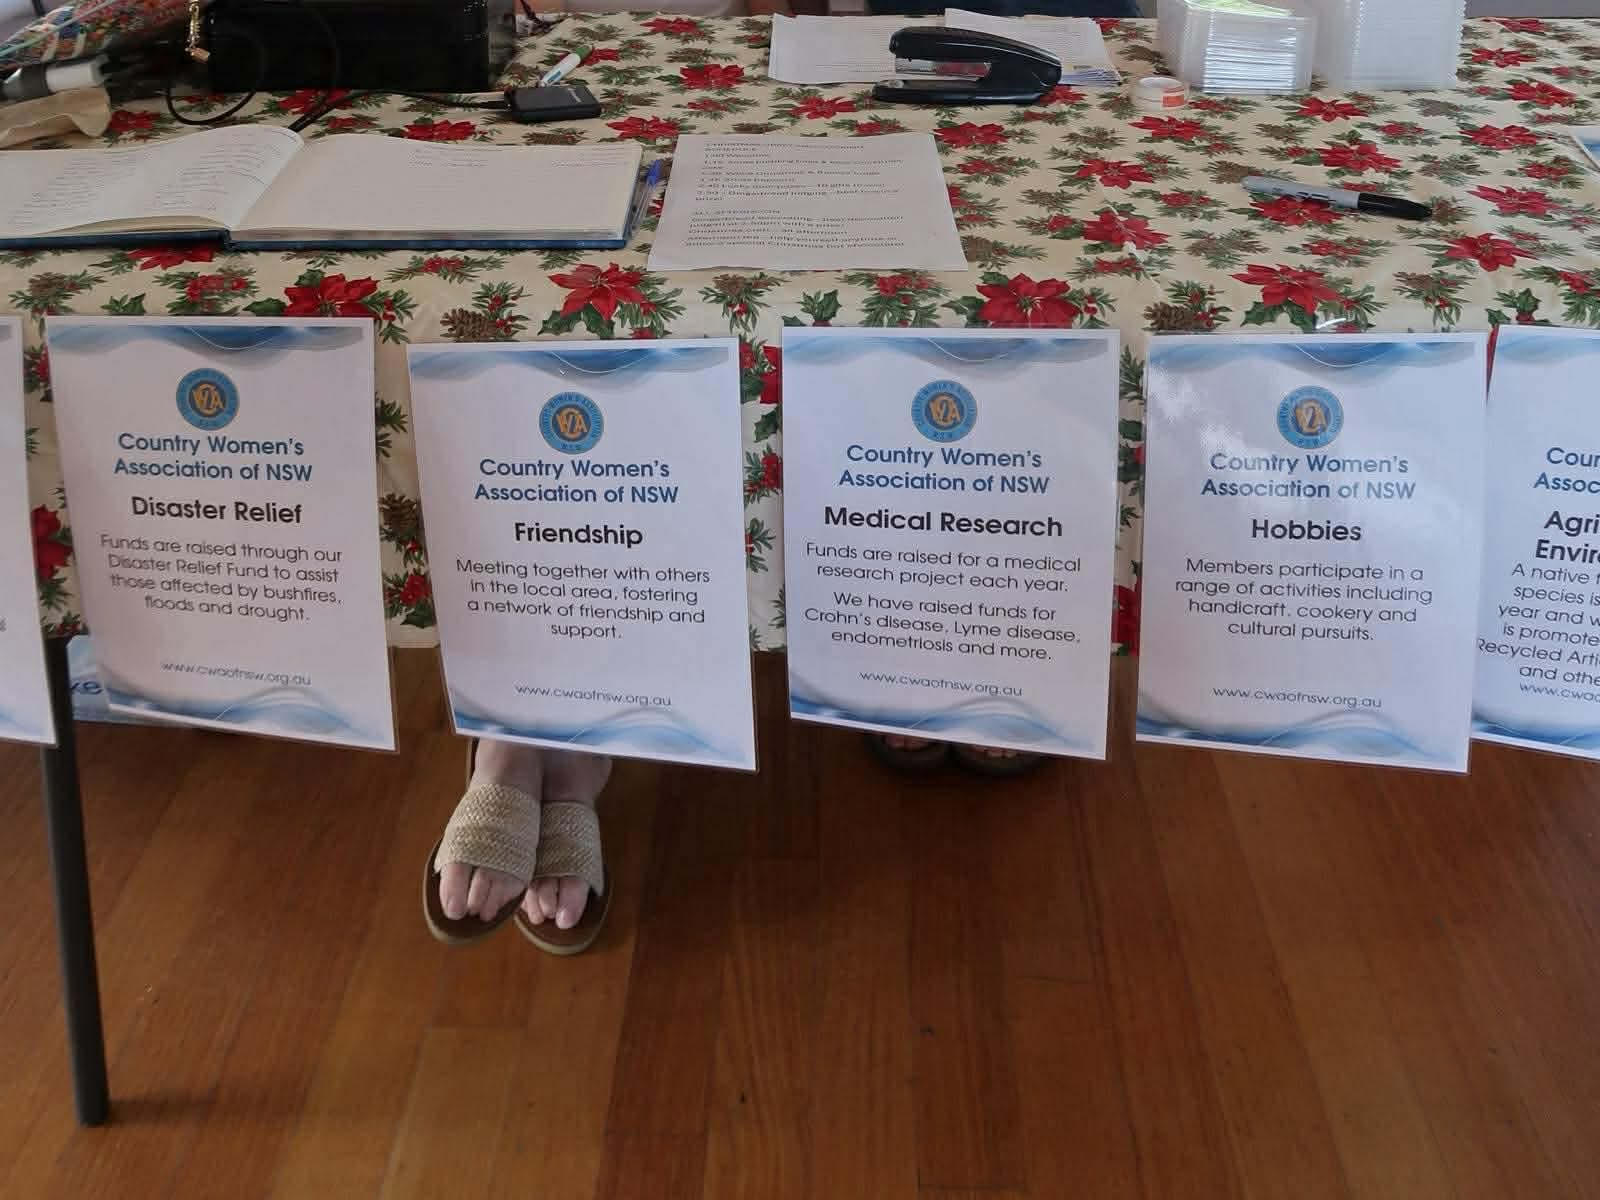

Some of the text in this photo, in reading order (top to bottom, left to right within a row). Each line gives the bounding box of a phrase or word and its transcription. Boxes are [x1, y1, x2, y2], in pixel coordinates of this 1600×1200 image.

[118, 432, 305, 457] Country Women's
[846, 444, 1042, 469] Country Women's
[114, 457, 313, 482] Association of NSW
[479, 458, 670, 481] Country Women's
[1210, 452, 1409, 475] Country Women's
[474, 483, 679, 504] Association of NSW
[838, 469, 1050, 494] Association of NSW
[1200, 478, 1416, 499] Association of NSW
[131, 496, 302, 524] Disaster Relief
[824, 506, 1063, 537] Medical Research
[514, 522, 644, 549] Friendship
[1252, 518, 1362, 541] Hobbies
[100, 534, 343, 564] Funds are raised through our
[806, 542, 1081, 572] Funds are raised for a medical
[108, 553, 339, 583] Disaster Relief Fund to assist
[456, 559, 711, 583] Meeting together with others
[817, 565, 1068, 593] research project each year.
[1186, 558, 1424, 582] Members participate in a
[1511, 562, 1526, 577] A
[1530, 567, 1591, 585] native
[110, 573, 342, 605] those affected by bushfires,
[470, 579, 698, 607] in the local area, fostering
[1175, 580, 1433, 606] range of activities including
[1513, 585, 1585, 605] species
[144, 595, 309, 623] floods and drought.
[467, 600, 705, 625] a network of friendship and
[833, 591, 1056, 621] We have raised funds for
[1296, 604, 1374, 624] cookery
[1378, 608, 1417, 622] and
[1498, 604, 1542, 620] year
[1544, 610, 1585, 625] and
[550, 624, 621, 642] support.
[804, 607, 872, 627] Crohn's
[954, 620, 1002, 638] Lyme
[1227, 620, 1374, 641] cultural pursuits.
[1503, 622, 1515, 637] is
[831, 631, 1052, 660] endometriosis and more.
[1519, 665, 1559, 681] and
